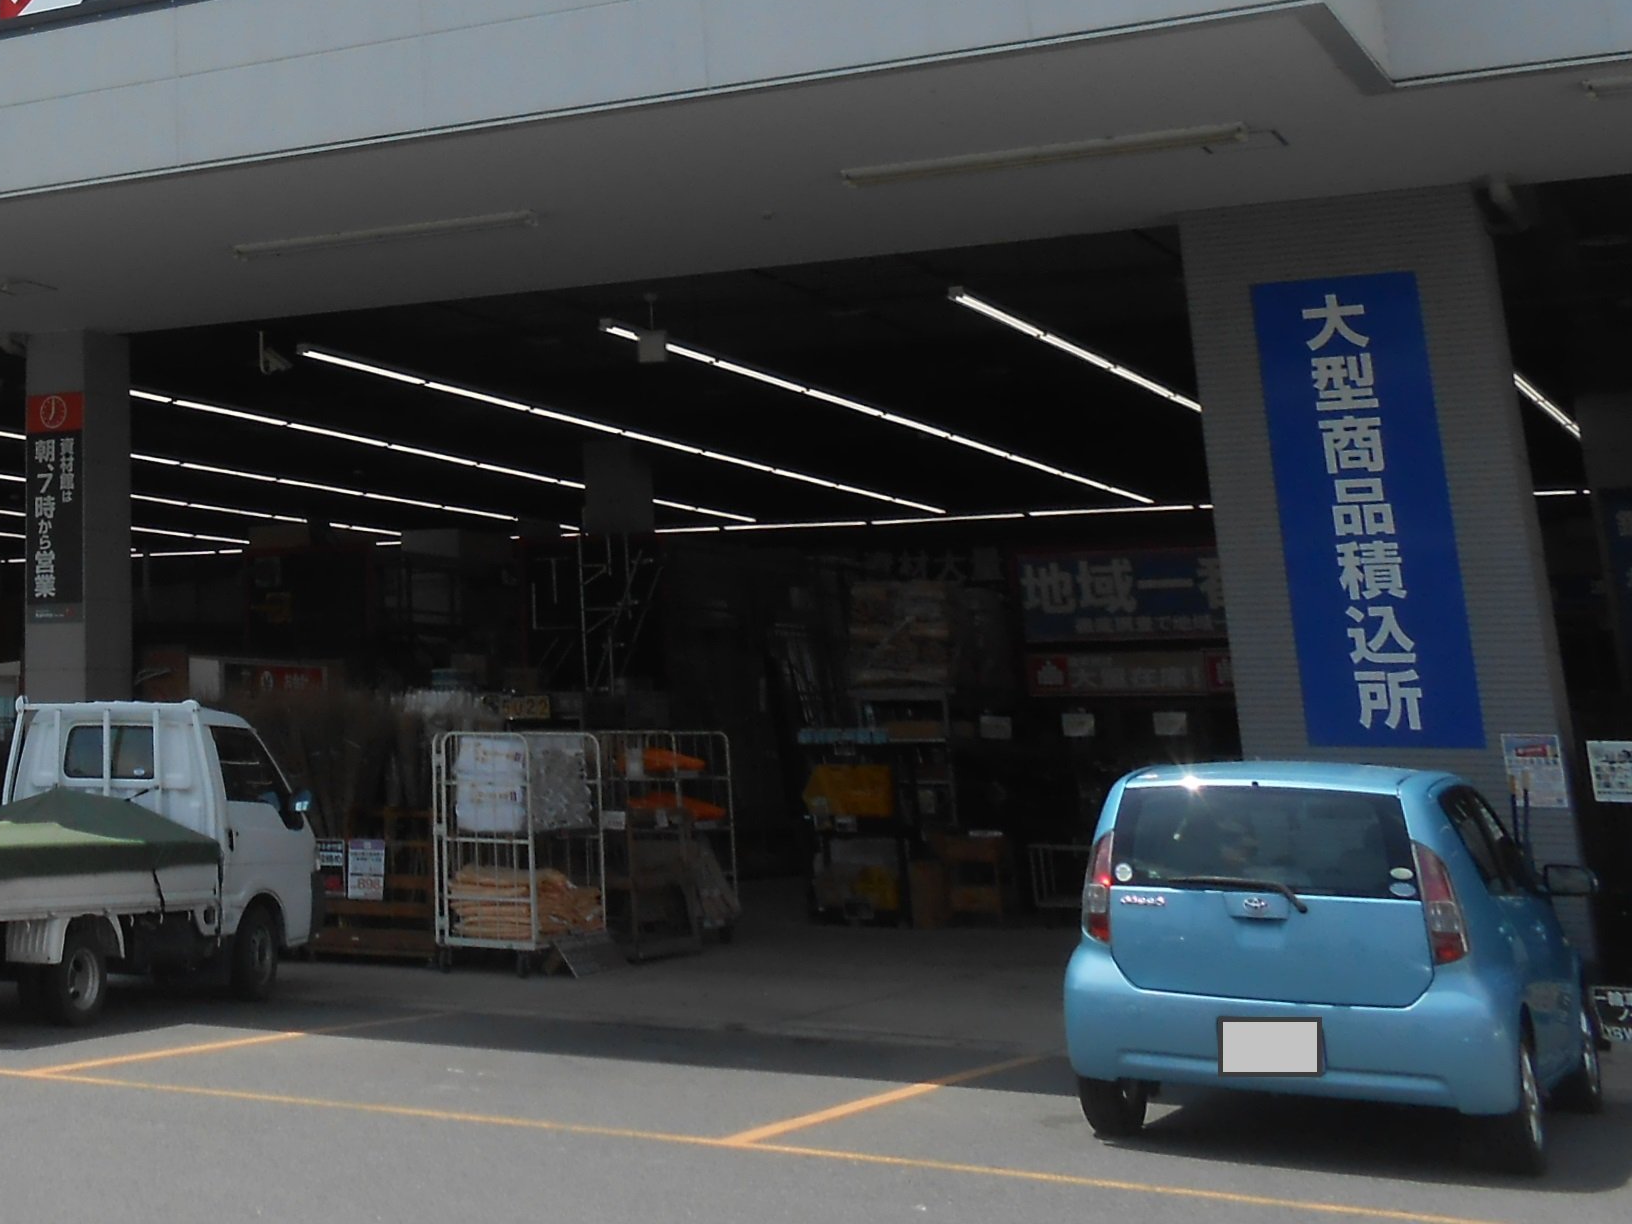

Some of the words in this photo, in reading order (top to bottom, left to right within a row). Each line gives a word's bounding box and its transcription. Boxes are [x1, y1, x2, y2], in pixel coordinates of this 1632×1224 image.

[59, 437, 75, 503] 資材館は
[1301, 293, 1424, 732] 大型商品積込所
